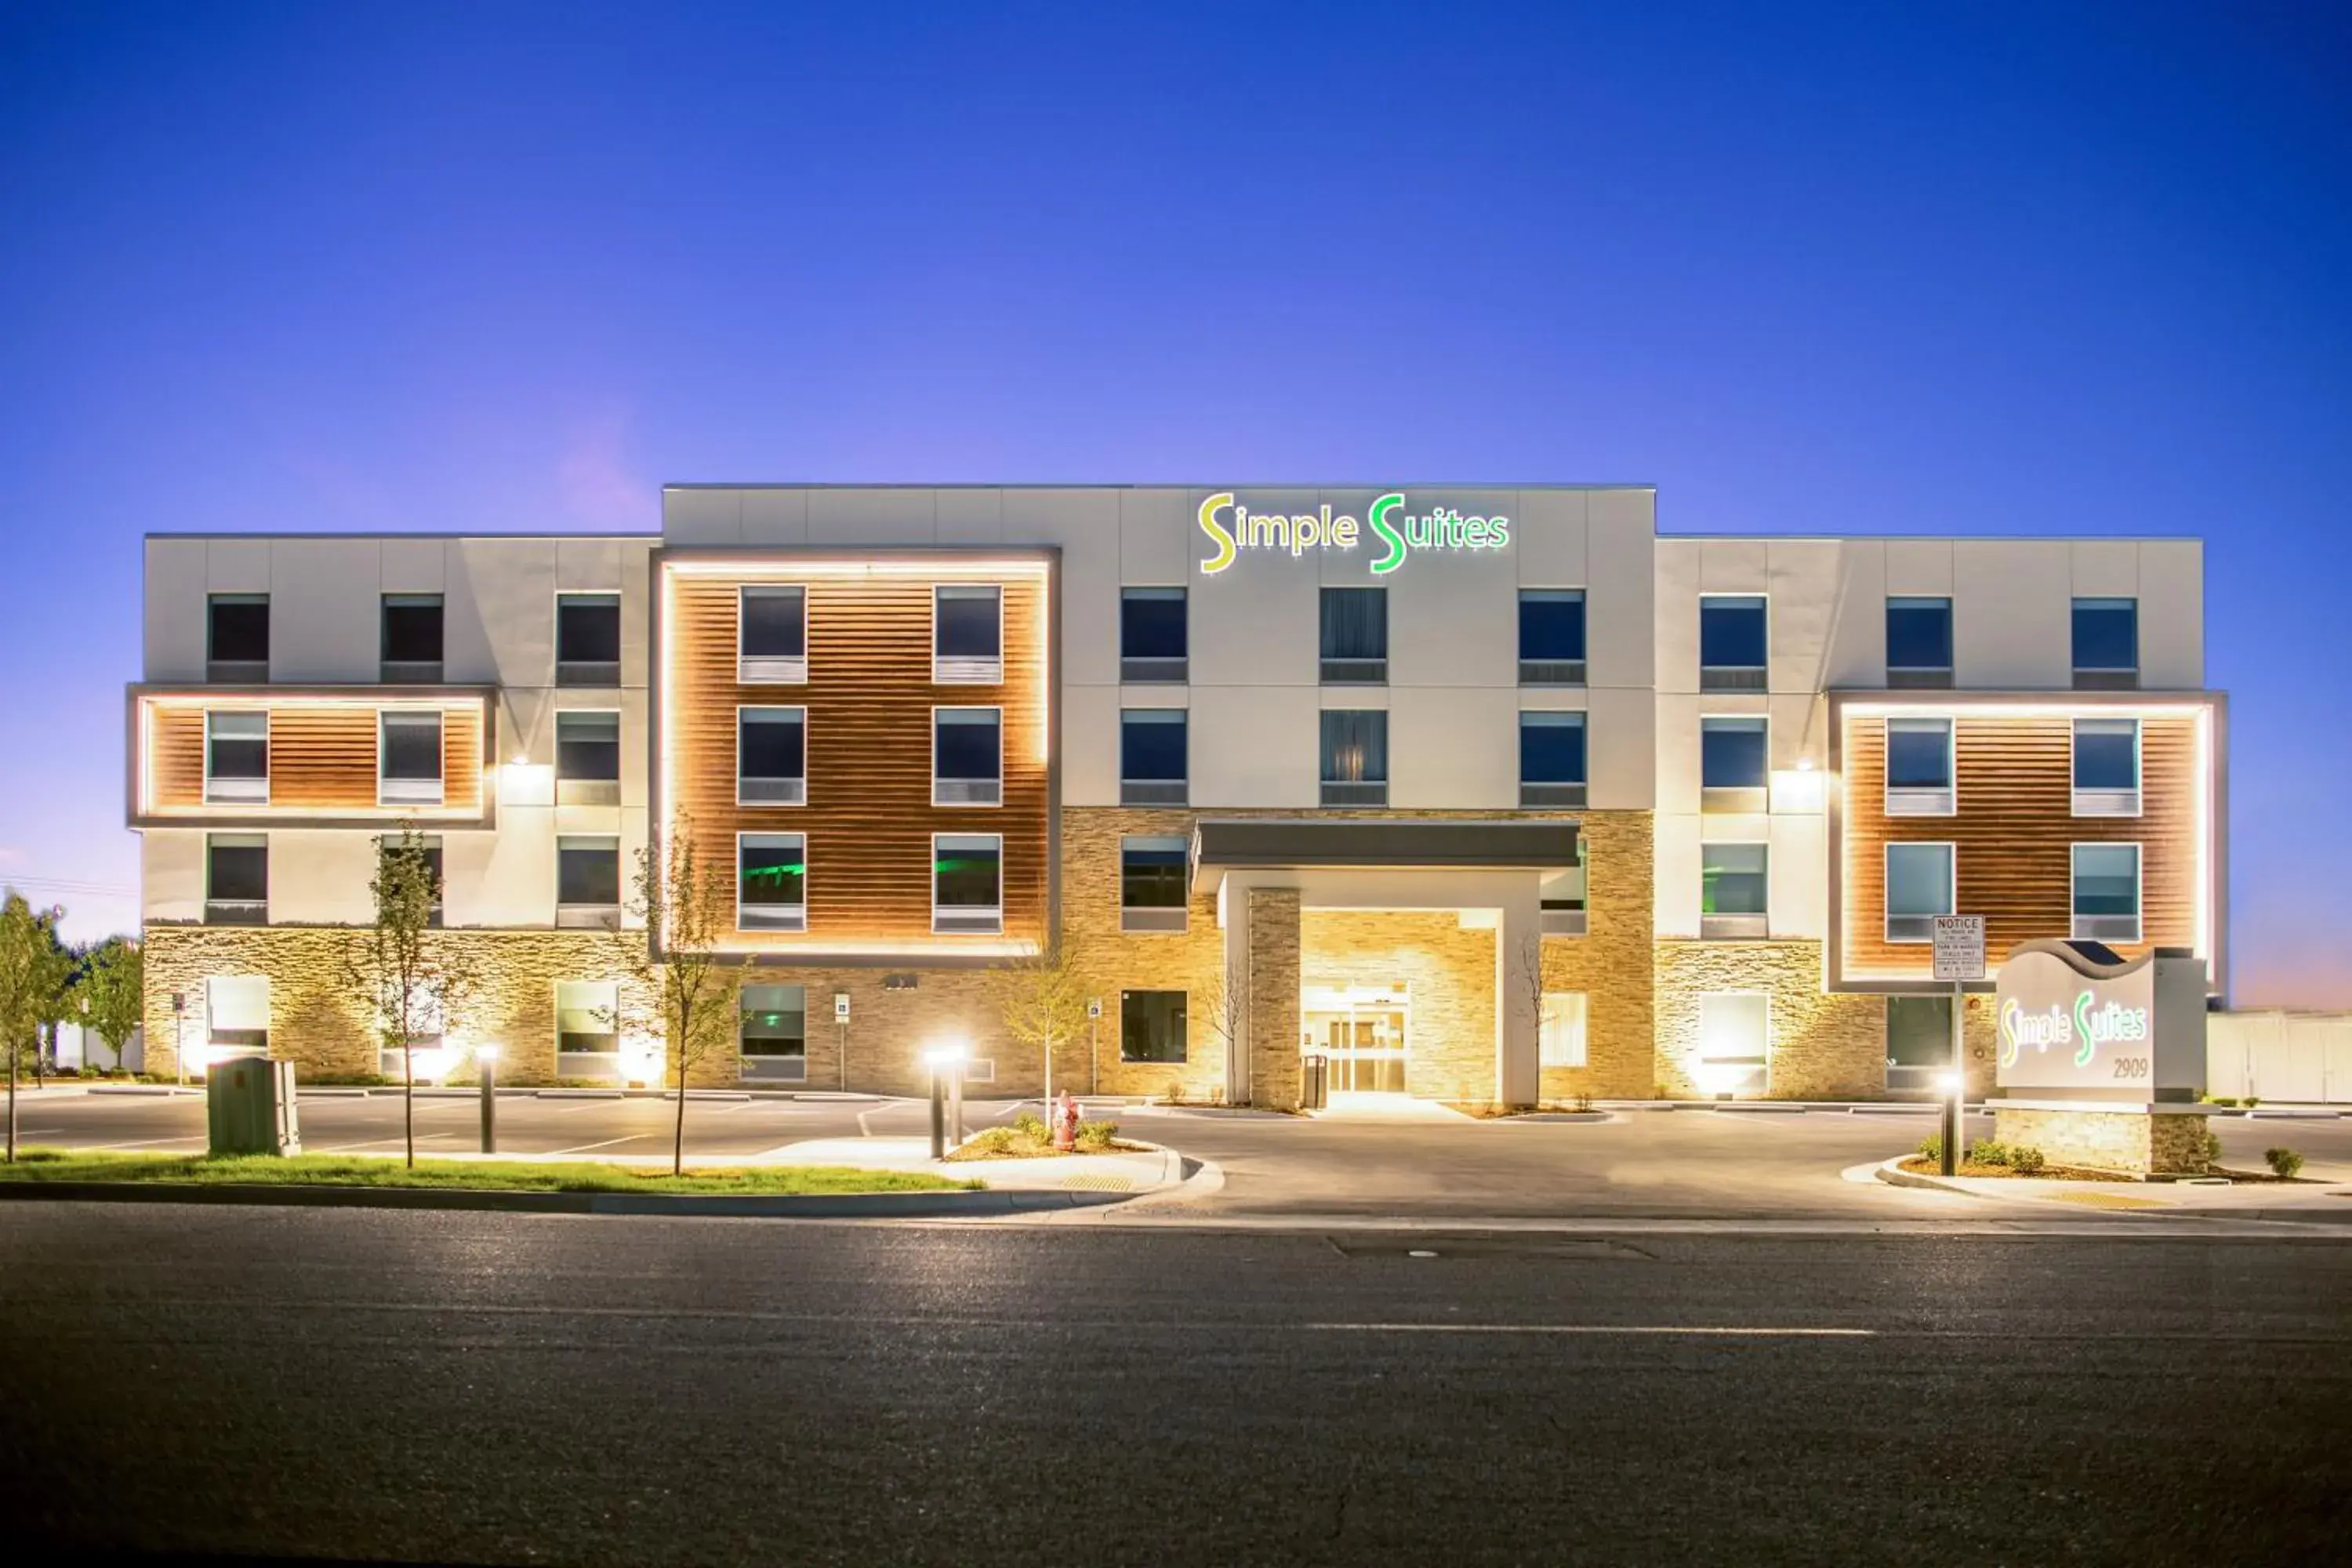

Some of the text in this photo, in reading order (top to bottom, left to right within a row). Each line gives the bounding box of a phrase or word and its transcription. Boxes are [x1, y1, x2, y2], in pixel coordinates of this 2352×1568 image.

[1198, 492, 1510, 574] Simple Suites
[1937, 918, 1978, 929] NOTICE
[2001, 991, 2146, 1068] Simple Suites
[2113, 1058, 2148, 1079] 2909
